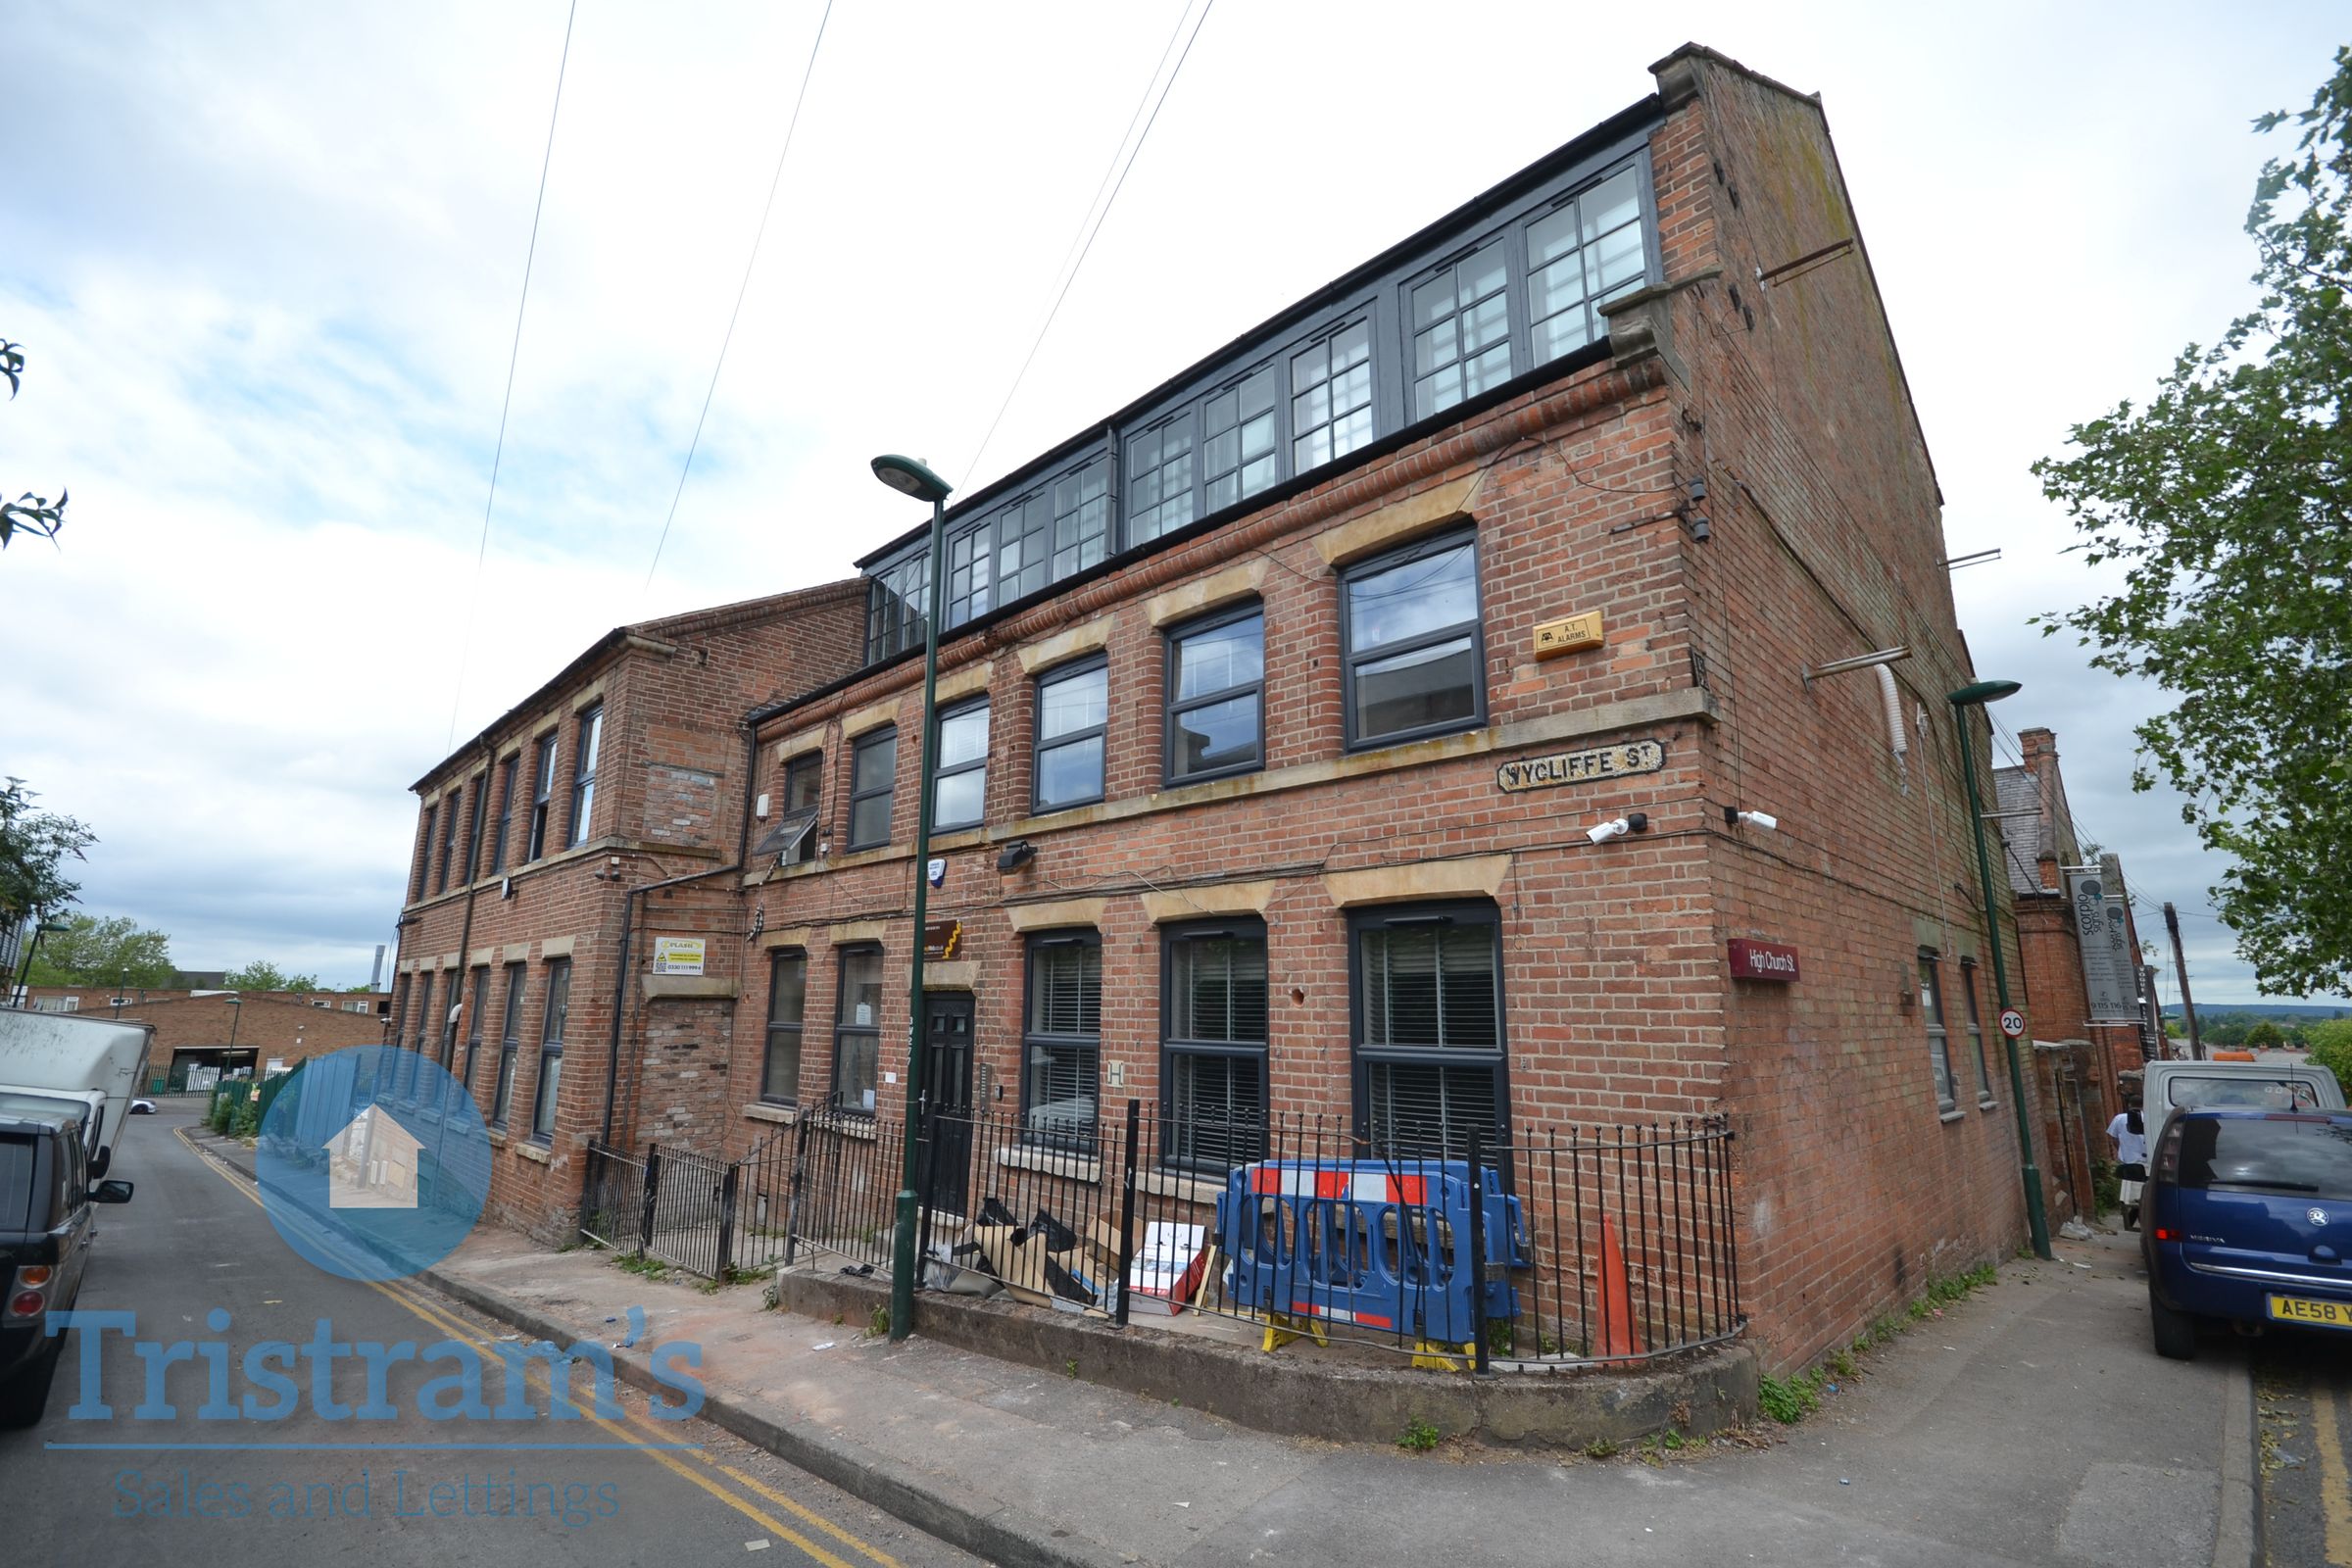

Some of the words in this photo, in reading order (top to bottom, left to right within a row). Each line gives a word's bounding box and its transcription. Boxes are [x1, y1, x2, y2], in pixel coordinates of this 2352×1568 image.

[1558, 630, 1586, 643] ALARMS
[1505, 752, 1613, 785] WYCLIFFE
[2075, 894, 2094, 936] scorpio
[2090, 911, 2104, 933] signs
[1749, 949, 1765, 972] High
[1765, 951, 1788, 970] Church
[2003, 1017, 2022, 1029] 20
[1109, 1063, 1121, 1085] H
[2282, 1299, 2336, 1320] AE58
